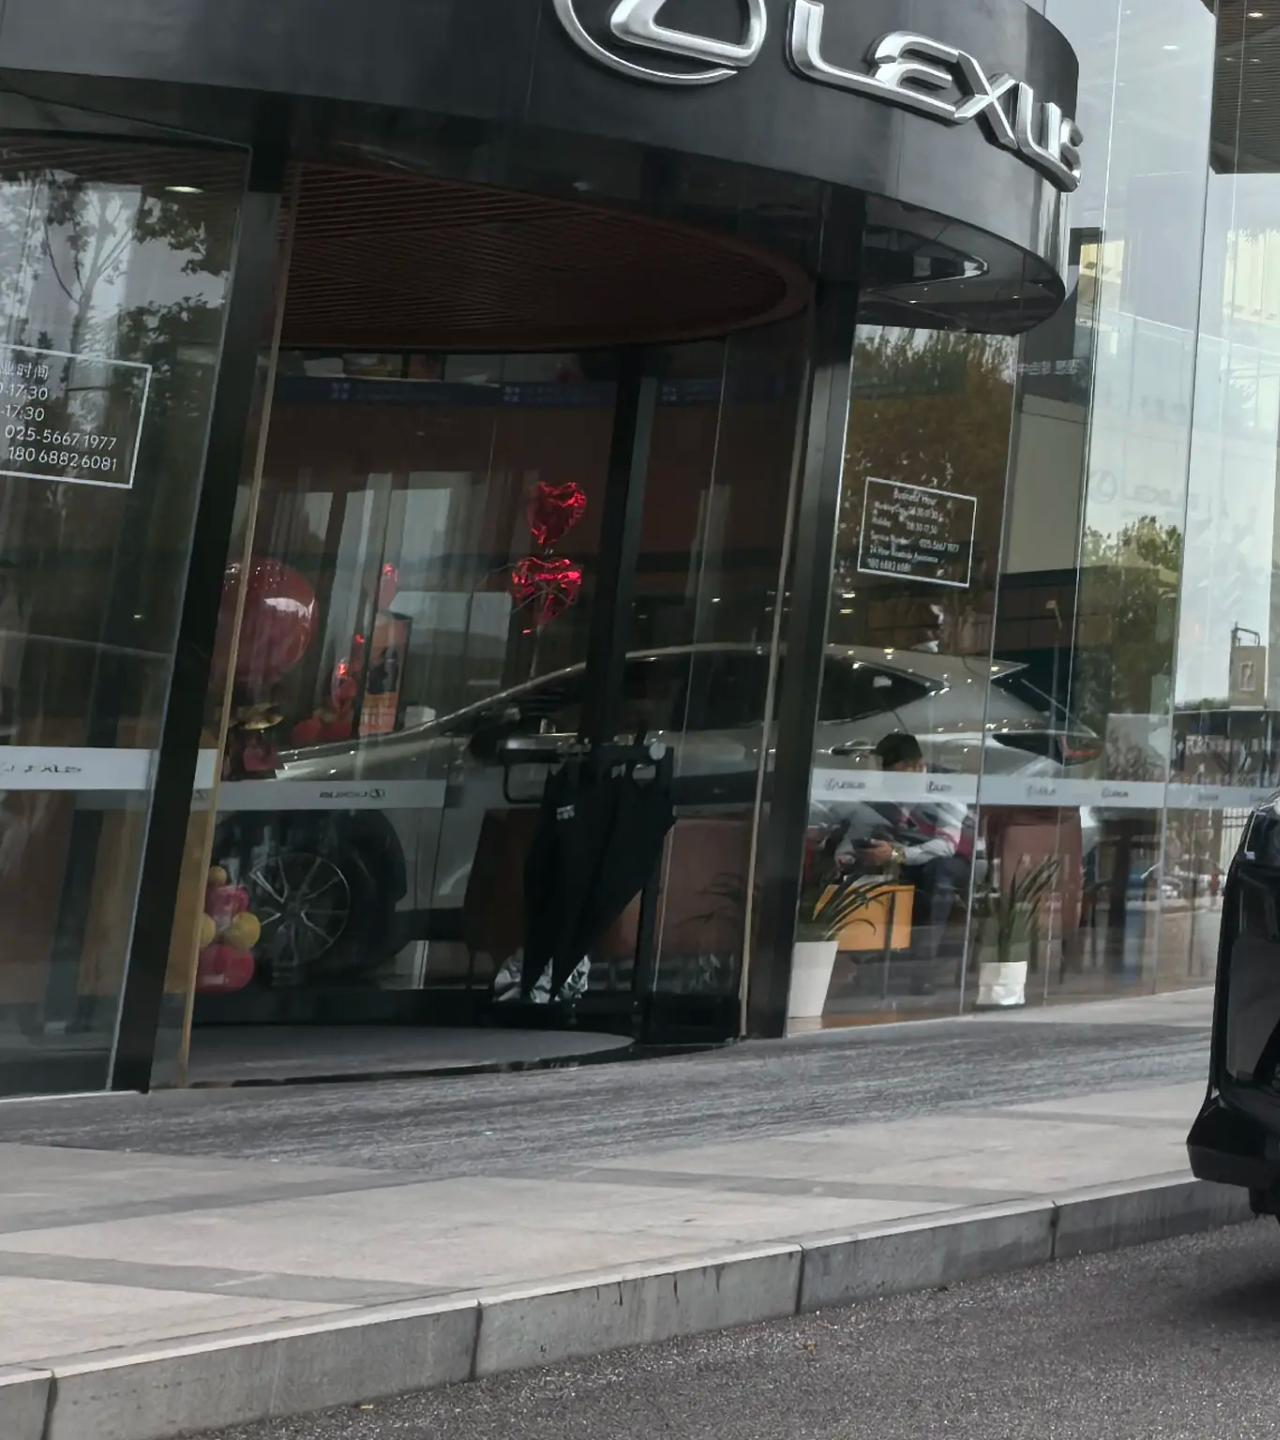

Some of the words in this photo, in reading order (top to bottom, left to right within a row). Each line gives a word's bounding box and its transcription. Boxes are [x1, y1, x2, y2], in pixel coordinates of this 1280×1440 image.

[5, 424, 80, 445] 025-5667
[84, 434, 117, 451] 1977
[8, 446, 36, 462] 180
[38, 449, 79, 467] 6882
[81, 455, 117, 472] 6081
